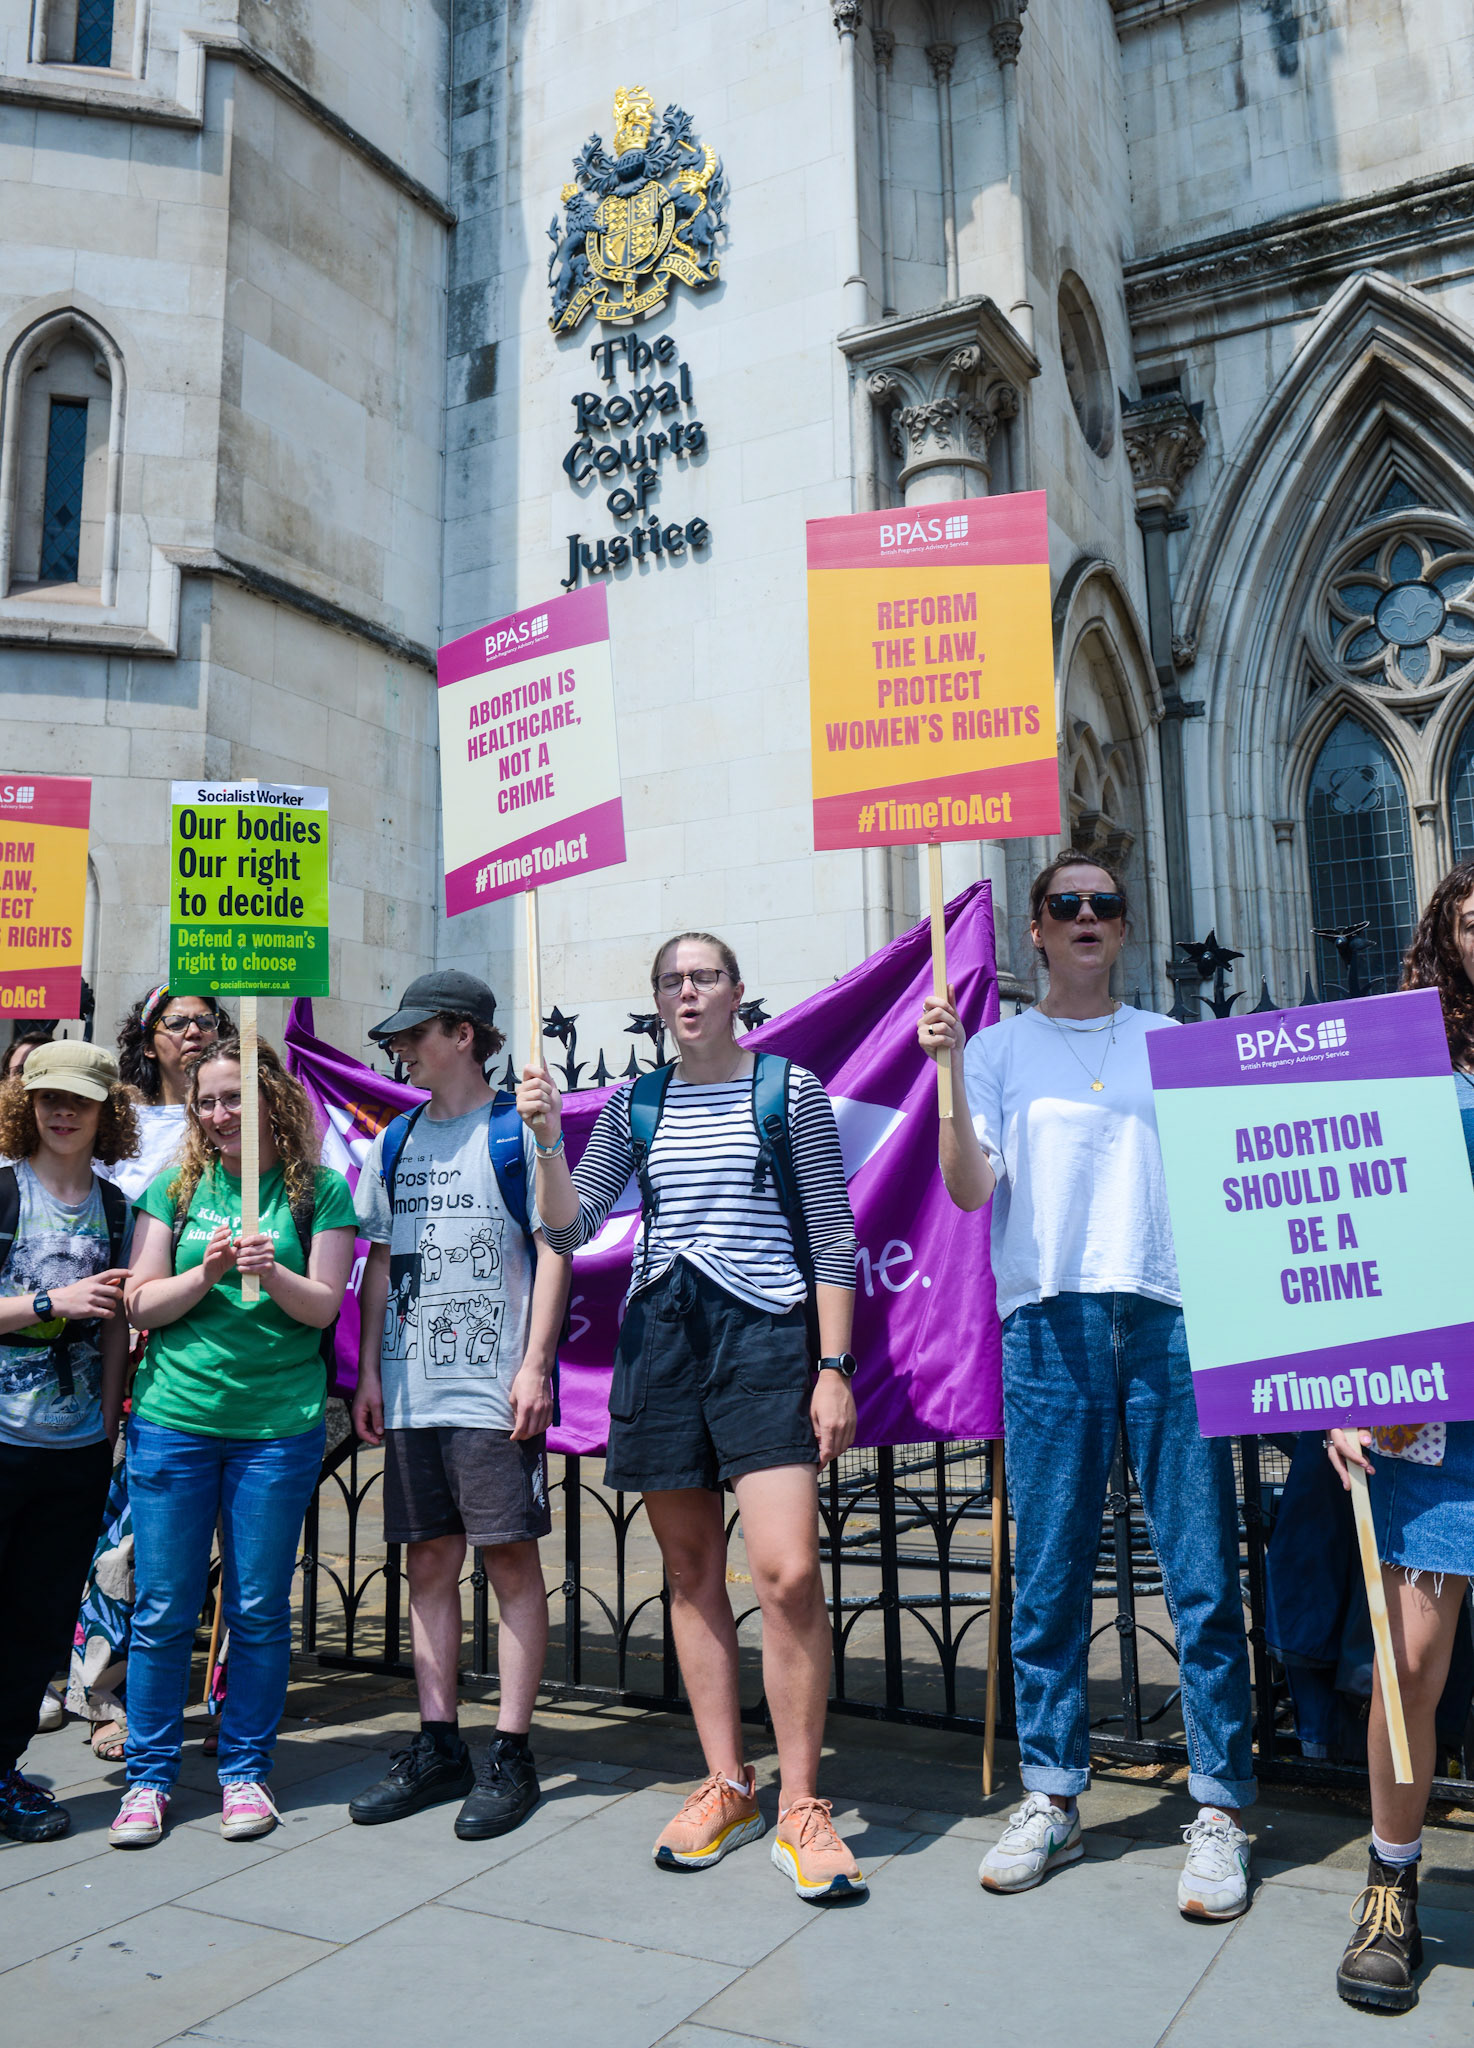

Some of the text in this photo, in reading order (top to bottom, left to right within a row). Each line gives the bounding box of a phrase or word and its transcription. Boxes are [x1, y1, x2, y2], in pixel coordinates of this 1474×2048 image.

[661, 256, 702, 284] DROIT
[591, 332, 675, 381] The
[571, 362, 692, 434] Royal
[562, 420, 704, 481] Courts
[606, 466, 658, 516] of
[560, 515, 708, 588] Justice
[880, 518, 942, 548] BPAS
[877, 592, 977, 631] REFORM
[485, 621, 530, 656] BPAS
[872, 631, 985, 670] THE LAW,
[469, 668, 576, 730] ABORTION IS
[878, 670, 983, 709] PROTECT
[467, 700, 582, 762] HEALTHCARE,
[825, 704, 1040, 752] WOMEN'S RIGHTS
[499, 742, 550, 782] NOT A
[197, 789, 304, 806] Socialist Worker
[497, 773, 555, 814] CRIME
[858, 791, 1013, 833] #TimeToAct
[179, 809, 321, 844] Our bodies
[179, 847, 301, 885] Our right
[475, 833, 589, 894] #TimeToAct
[179, 885, 304, 918] to decide
[8, 926, 72, 948] RIGHTS
[177, 928, 316, 949] Defend a woman's
[177, 952, 297, 975] right to choose
[220, 980, 291, 990] socialistworker.co.uk
[1236, 1024, 1315, 1061] BPAS
[1240, 1050, 1350, 1071] British Pregnancy Advisory Service
[1235, 1110, 1384, 1164] ABORTION
[1222, 1156, 1408, 1213] SHOULD NOT
[1288, 1213, 1359, 1255] BE A
[1280, 1260, 1383, 1305] CRIME
[1251, 1362, 1449, 1414] #TimeToAct
